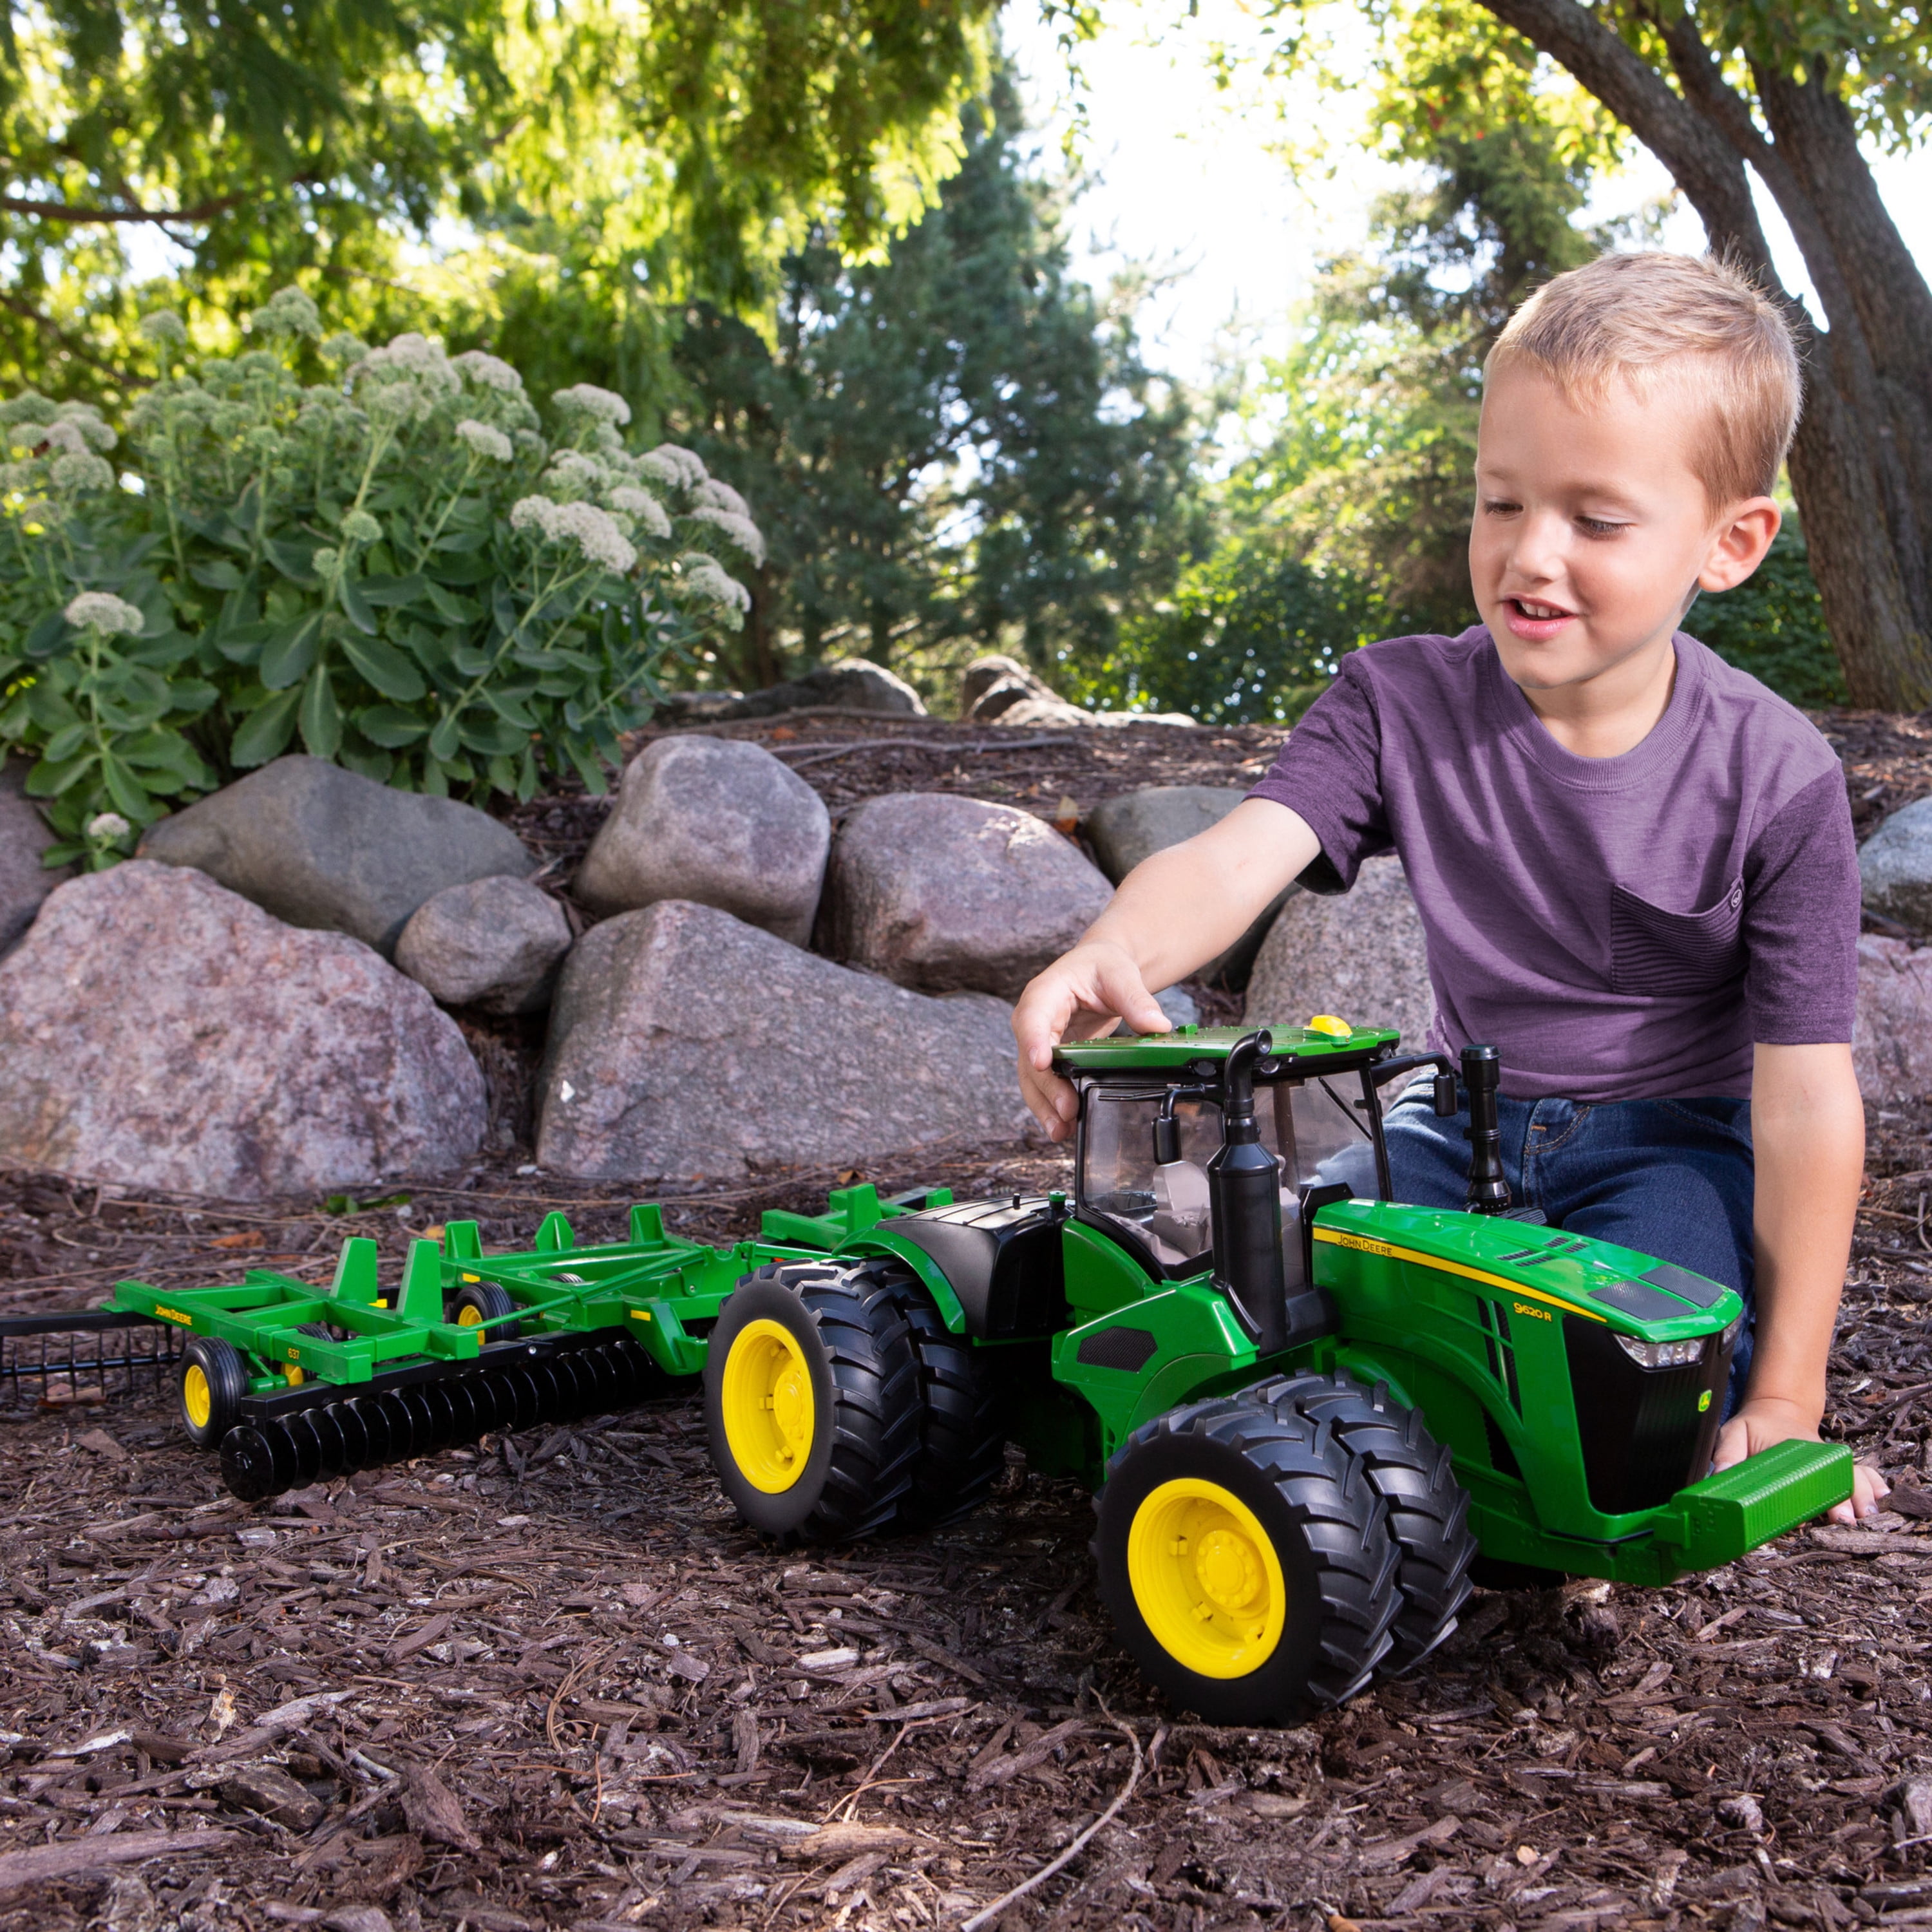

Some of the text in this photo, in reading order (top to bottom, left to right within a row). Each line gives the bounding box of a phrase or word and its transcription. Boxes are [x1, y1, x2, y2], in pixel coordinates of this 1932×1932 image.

[1338, 1235, 1392, 1256] JOHN DEERE
[155, 1304, 192, 1325] JOHN DEERE
[288, 1347, 299, 1359] 637
